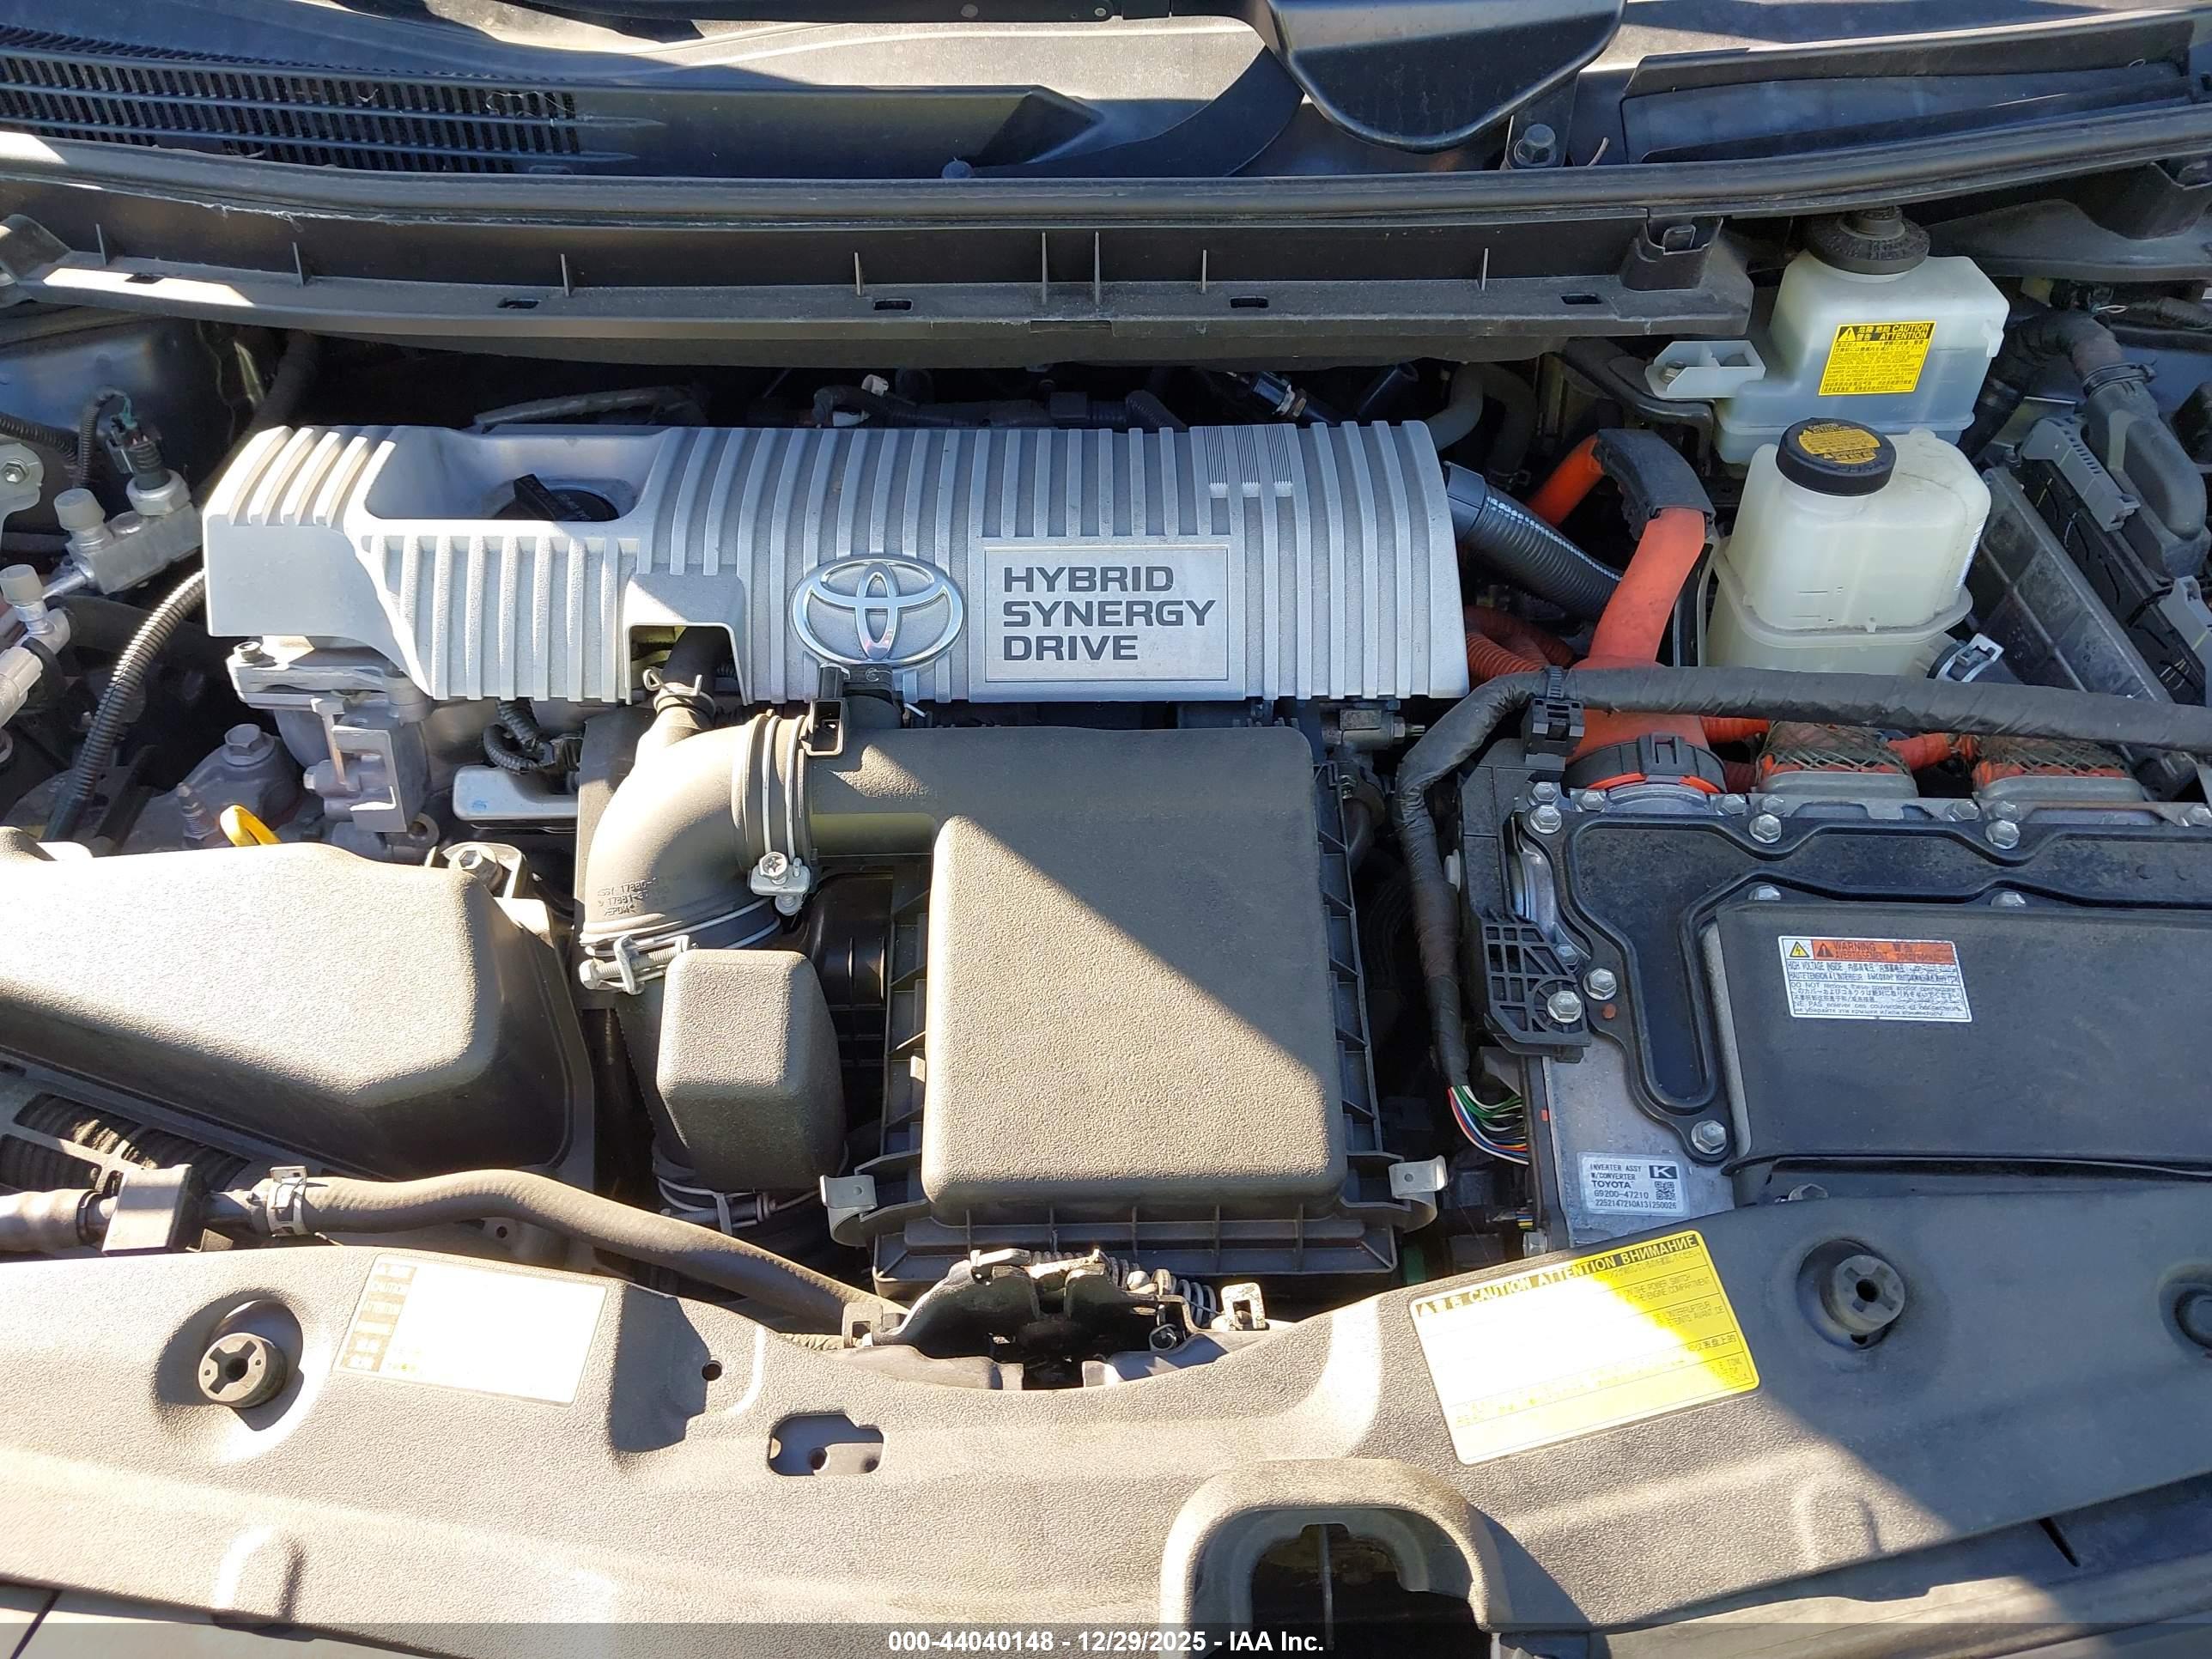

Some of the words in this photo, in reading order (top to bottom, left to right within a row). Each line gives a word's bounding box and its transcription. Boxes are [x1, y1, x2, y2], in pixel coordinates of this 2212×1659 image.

[1892, 324, 1930, 333] CAUTION
[1879, 331, 1927, 341] ATTENTION
[1004, 566, 1174, 592] HYBRID
[1002, 599, 1216, 628] SYNERGY
[1004, 635, 1139, 661] DRIVE
[1833, 941, 1876, 951] WARNING
[1625, 1164, 1642, 1173] ASSY
[1590, 1172, 1636, 1181] W/CONVERTER
[1591, 1180, 1632, 1189] TOYOTA
[1594, 1189, 1650, 1200] G9200-47210
[1468, 1276, 1533, 1303] CAUTION
[1537, 1256, 1617, 1287] ATTENTION
[1620, 1235, 1698, 1264] ВНИМАНИЕ
